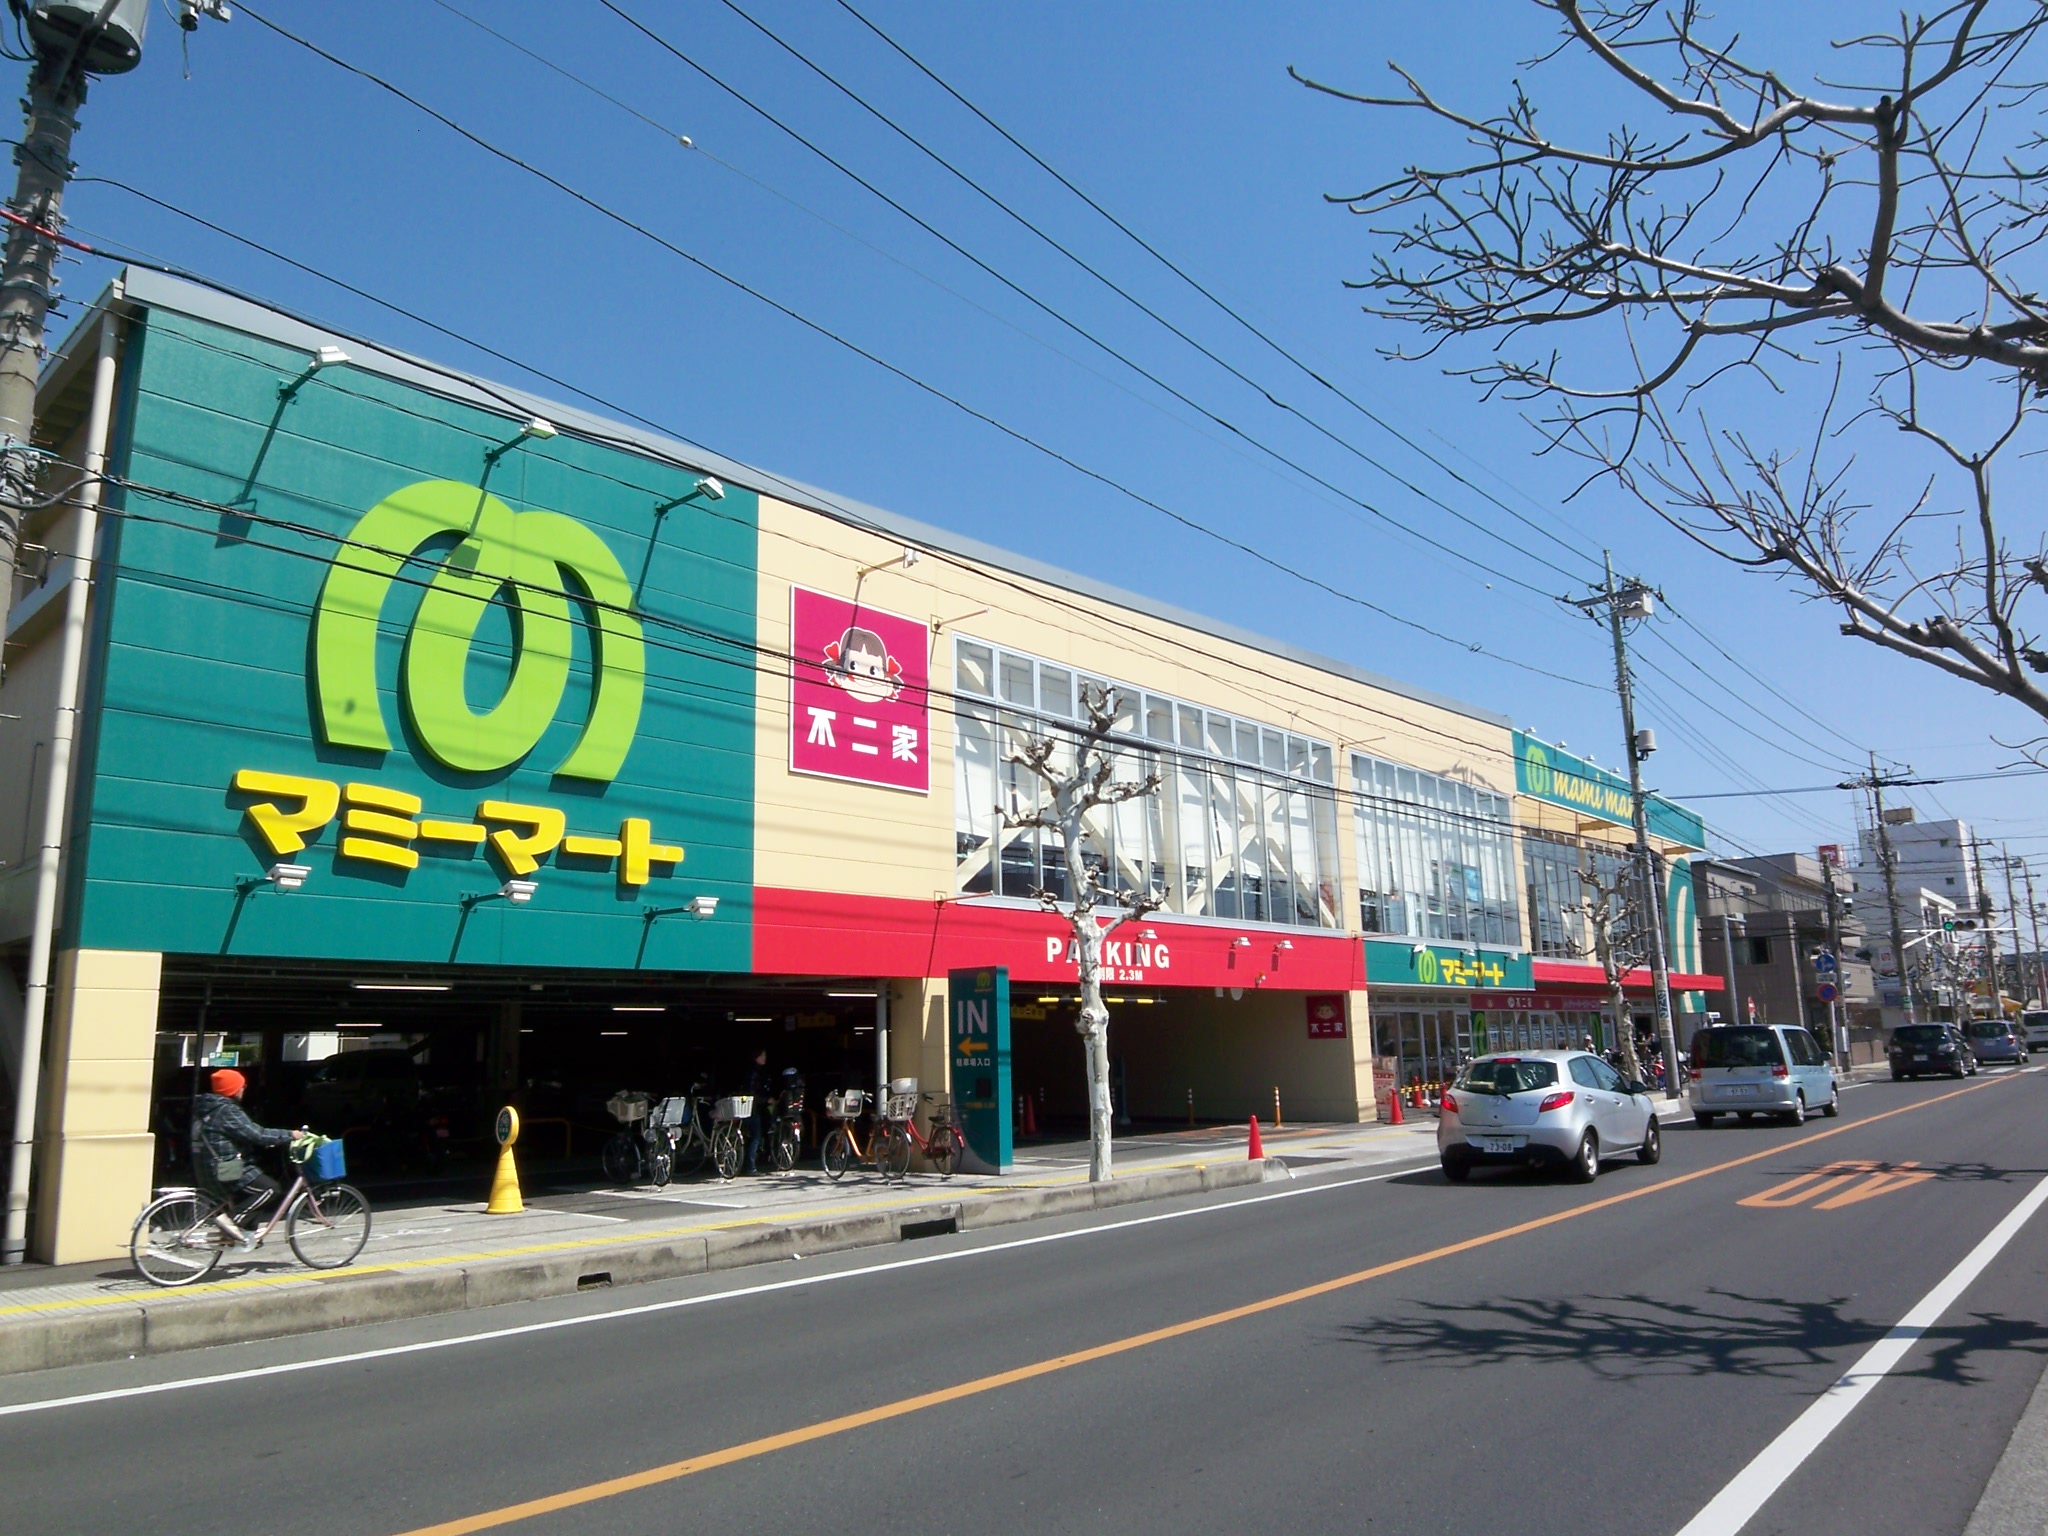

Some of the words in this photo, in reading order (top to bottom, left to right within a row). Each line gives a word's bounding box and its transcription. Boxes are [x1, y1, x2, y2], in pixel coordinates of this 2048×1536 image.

[807, 707, 918, 763] 不二家
[1554, 771, 1604, 808] mami
[233, 769, 684, 885] マミーマート
[1046, 937, 1170, 968] PAKING
[1119, 969, 1143, 981] 2.3M
[1440, 958, 1504, 986] マミーマート
[957, 999, 988, 1034] IN
[1310, 1022, 1343, 1033] 不二家
